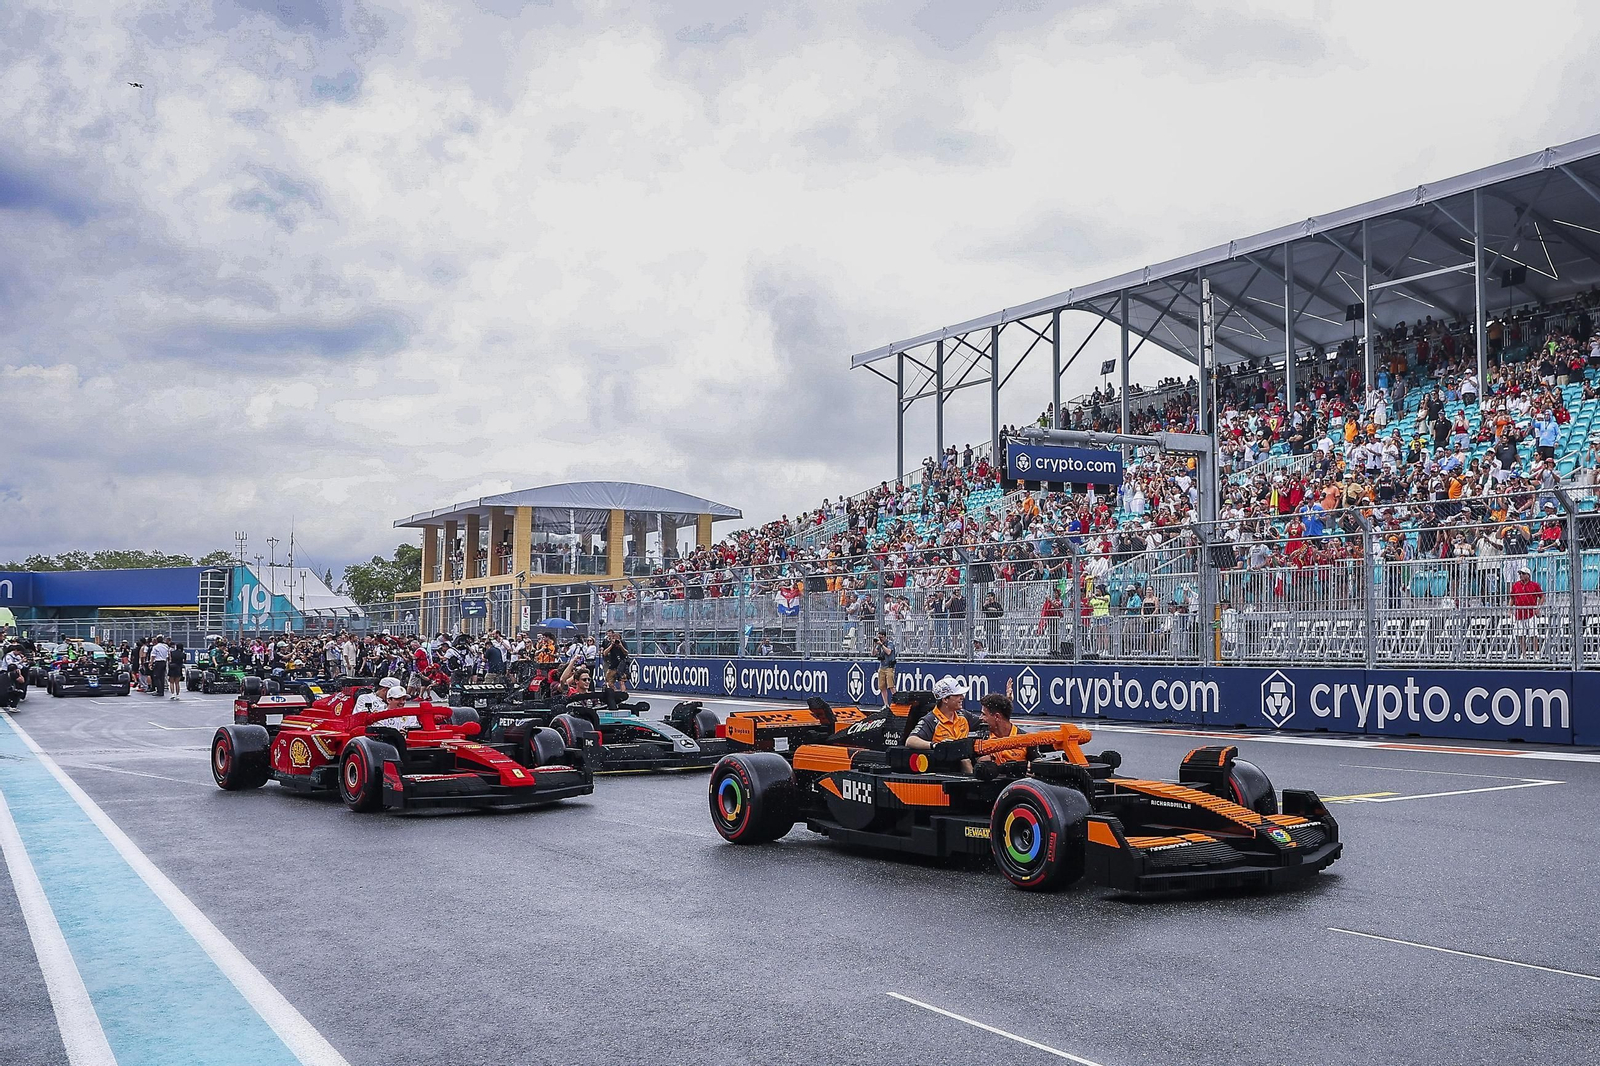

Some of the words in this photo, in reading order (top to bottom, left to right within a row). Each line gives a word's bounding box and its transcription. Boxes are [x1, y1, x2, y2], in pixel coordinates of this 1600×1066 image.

[1035, 457, 1116, 473] crypto.com
[237, 583, 272, 625] 19
[643, 661, 710, 689] crypto.com
[741, 664, 828, 695] crypto.com
[871, 667, 989, 701] cptom
[1049, 671, 1220, 714] crypto.com
[1310, 677, 1569, 729] crypto.com
[842, 779, 872, 804] OKX
